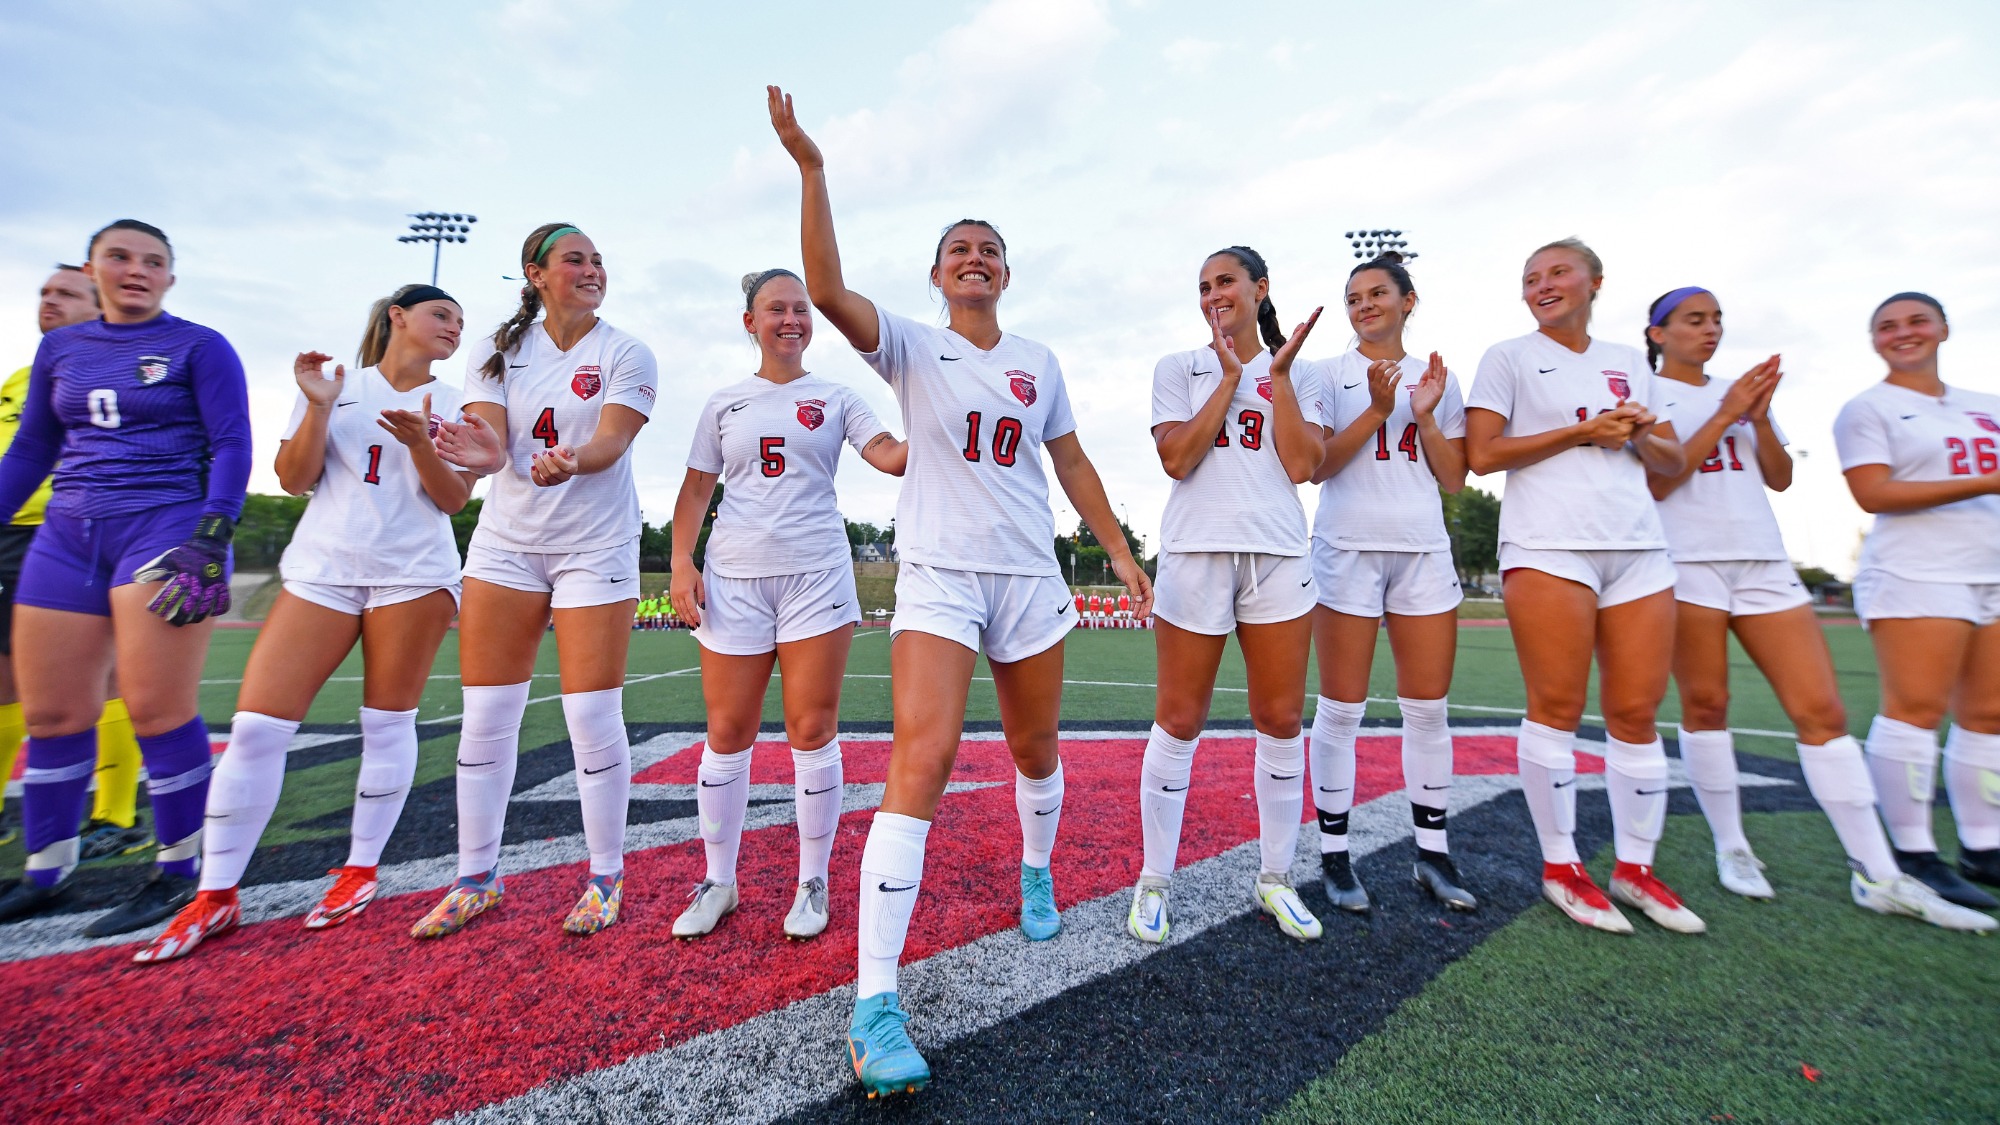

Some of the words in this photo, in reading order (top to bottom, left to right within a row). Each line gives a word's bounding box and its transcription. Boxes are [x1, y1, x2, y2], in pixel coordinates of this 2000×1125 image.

[87, 388, 121, 429] 0
[532, 407, 559, 448] 4
[963, 411, 1023, 467] 10
[1213, 409, 1264, 451] 13
[1375, 419, 1418, 462] 14
[363, 444, 382, 485] 1
[760, 436, 785, 478] 5
[1945, 437, 1998, 475] 26
